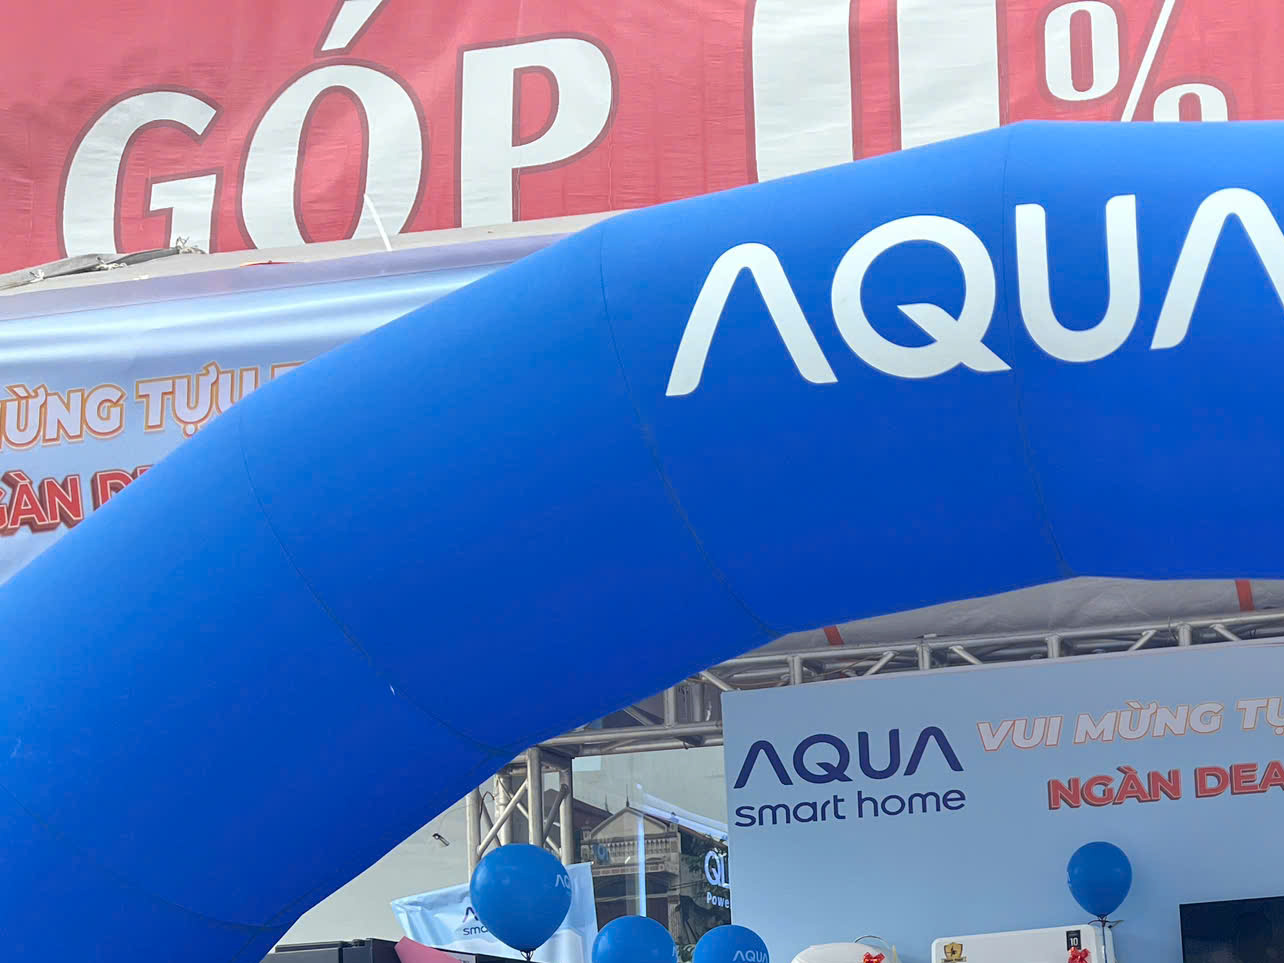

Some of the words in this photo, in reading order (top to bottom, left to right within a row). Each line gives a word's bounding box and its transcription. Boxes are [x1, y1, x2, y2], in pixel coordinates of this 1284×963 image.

[0, 384, 126, 449] ỪNG
[976, 715, 1063, 752] VUI
[1073, 699, 1225, 745] MỪNG
[733, 726, 964, 789] AQUA
[734, 795, 846, 827] smart
[857, 789, 966, 818] home
[1047, 765, 1182, 811] NGÀN
[732, 950, 769, 963] AQUA
[1069, 937, 1078, 946] 10
